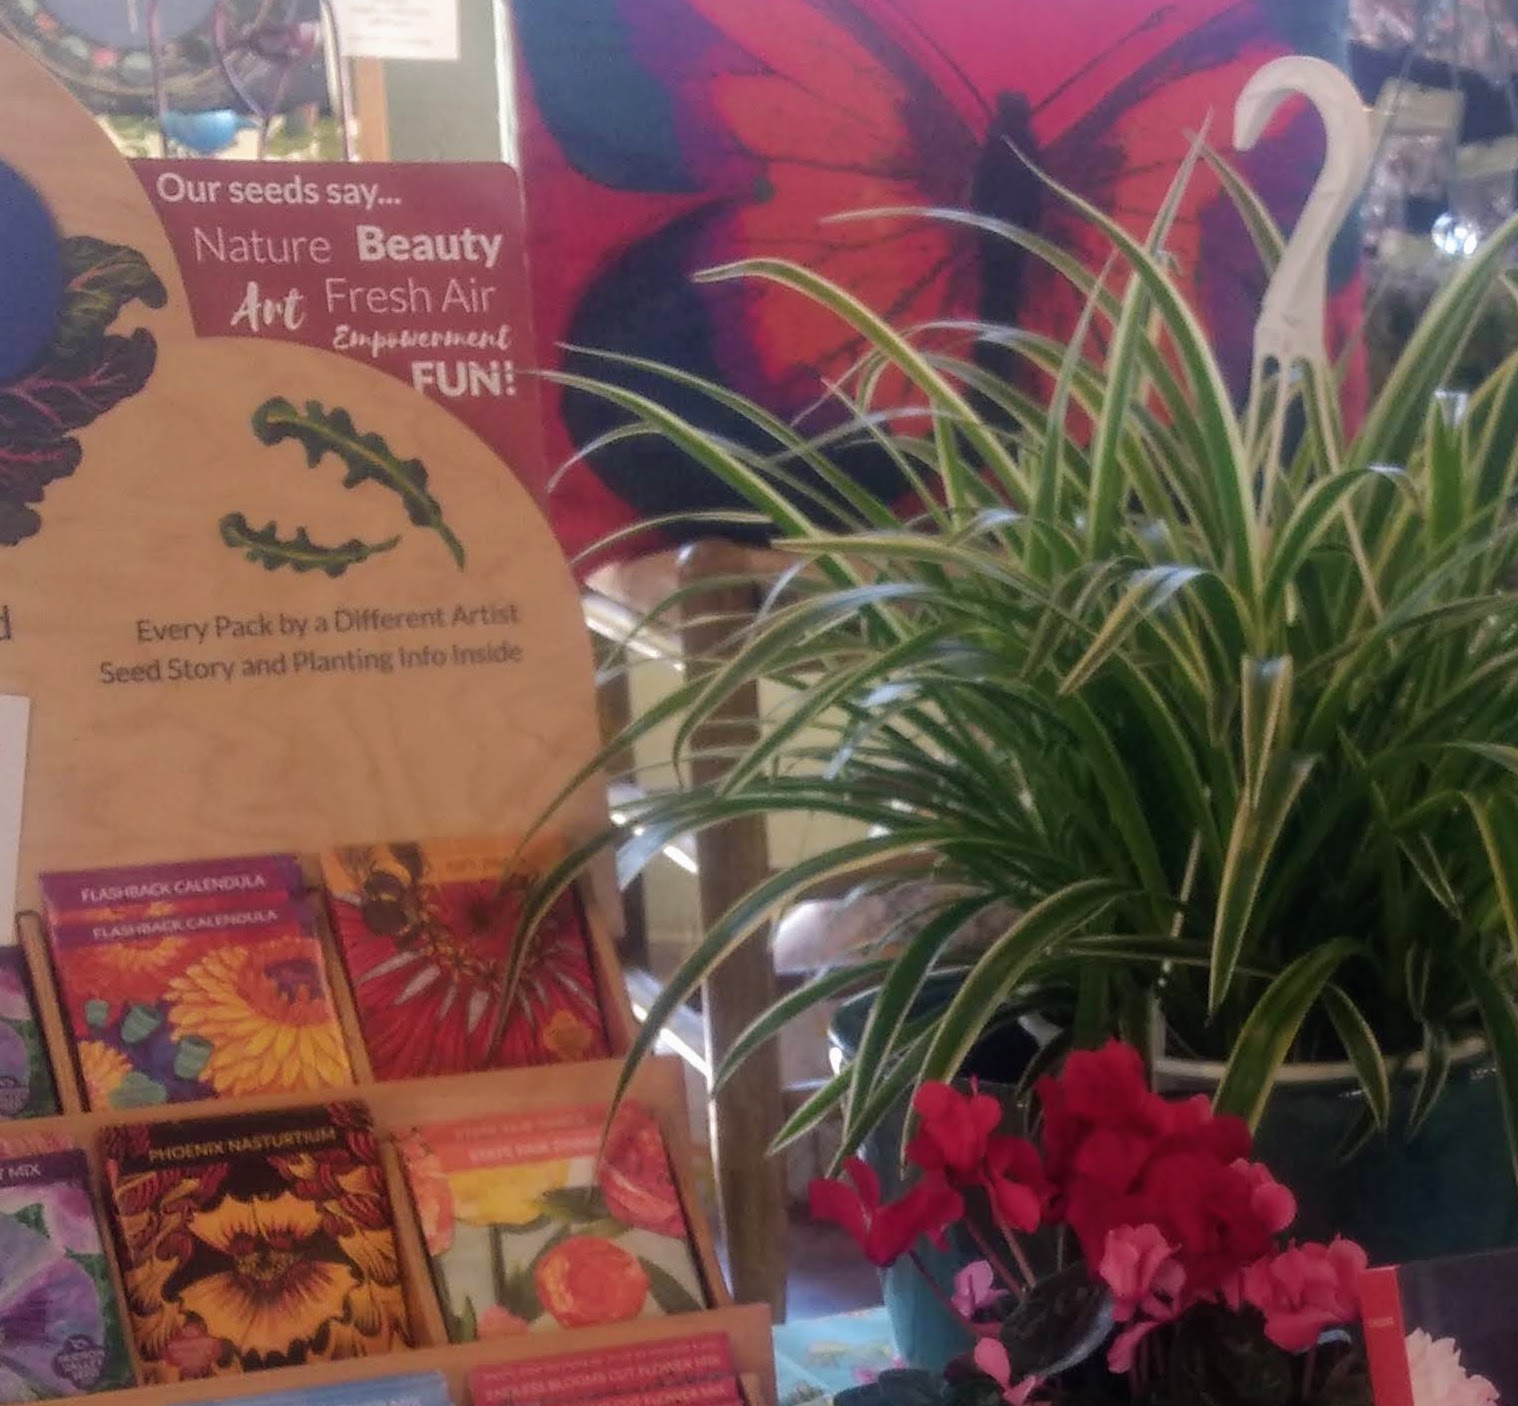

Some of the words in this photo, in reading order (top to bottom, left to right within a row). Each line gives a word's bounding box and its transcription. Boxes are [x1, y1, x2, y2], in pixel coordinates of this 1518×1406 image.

[156, 172, 220, 203] Our
[229, 176, 320, 204] seeds
[326, 183, 402, 210] say...
[193, 226, 332, 264] Nature
[356, 225, 502, 268] Beauty
[230, 281, 305, 332] Art
[325, 277, 430, 313] Fresh
[441, 277, 497, 313] Air
[333, 325, 512, 358] Empowerment
[411, 360, 516, 397] FUN!
[137, 618, 208, 644] Every
[216, 612, 274, 638] Pack
[280, 611, 308, 638] by
[315, 616, 329, 634] a
[334, 608, 446, 632] Different
[451, 603, 520, 627] Artist
[100, 660, 161, 685] Seed
[168, 657, 235, 682] Story
[242, 654, 287, 677] and
[294, 648, 394, 674] Planting
[399, 646, 447, 669] Info
[452, 641, 524, 665] Inside
[81, 882, 170, 902] FLASHBACK
[173, 873, 266, 893] CALENDULA
[93, 920, 183, 940] FLASHBACK
[186, 909, 279, 930] CALENDULA
[148, 1142, 224, 1162] PHOENIX
[228, 1126, 336, 1152] NASTURTIUM
[8, 1163, 42, 1178] MIX
